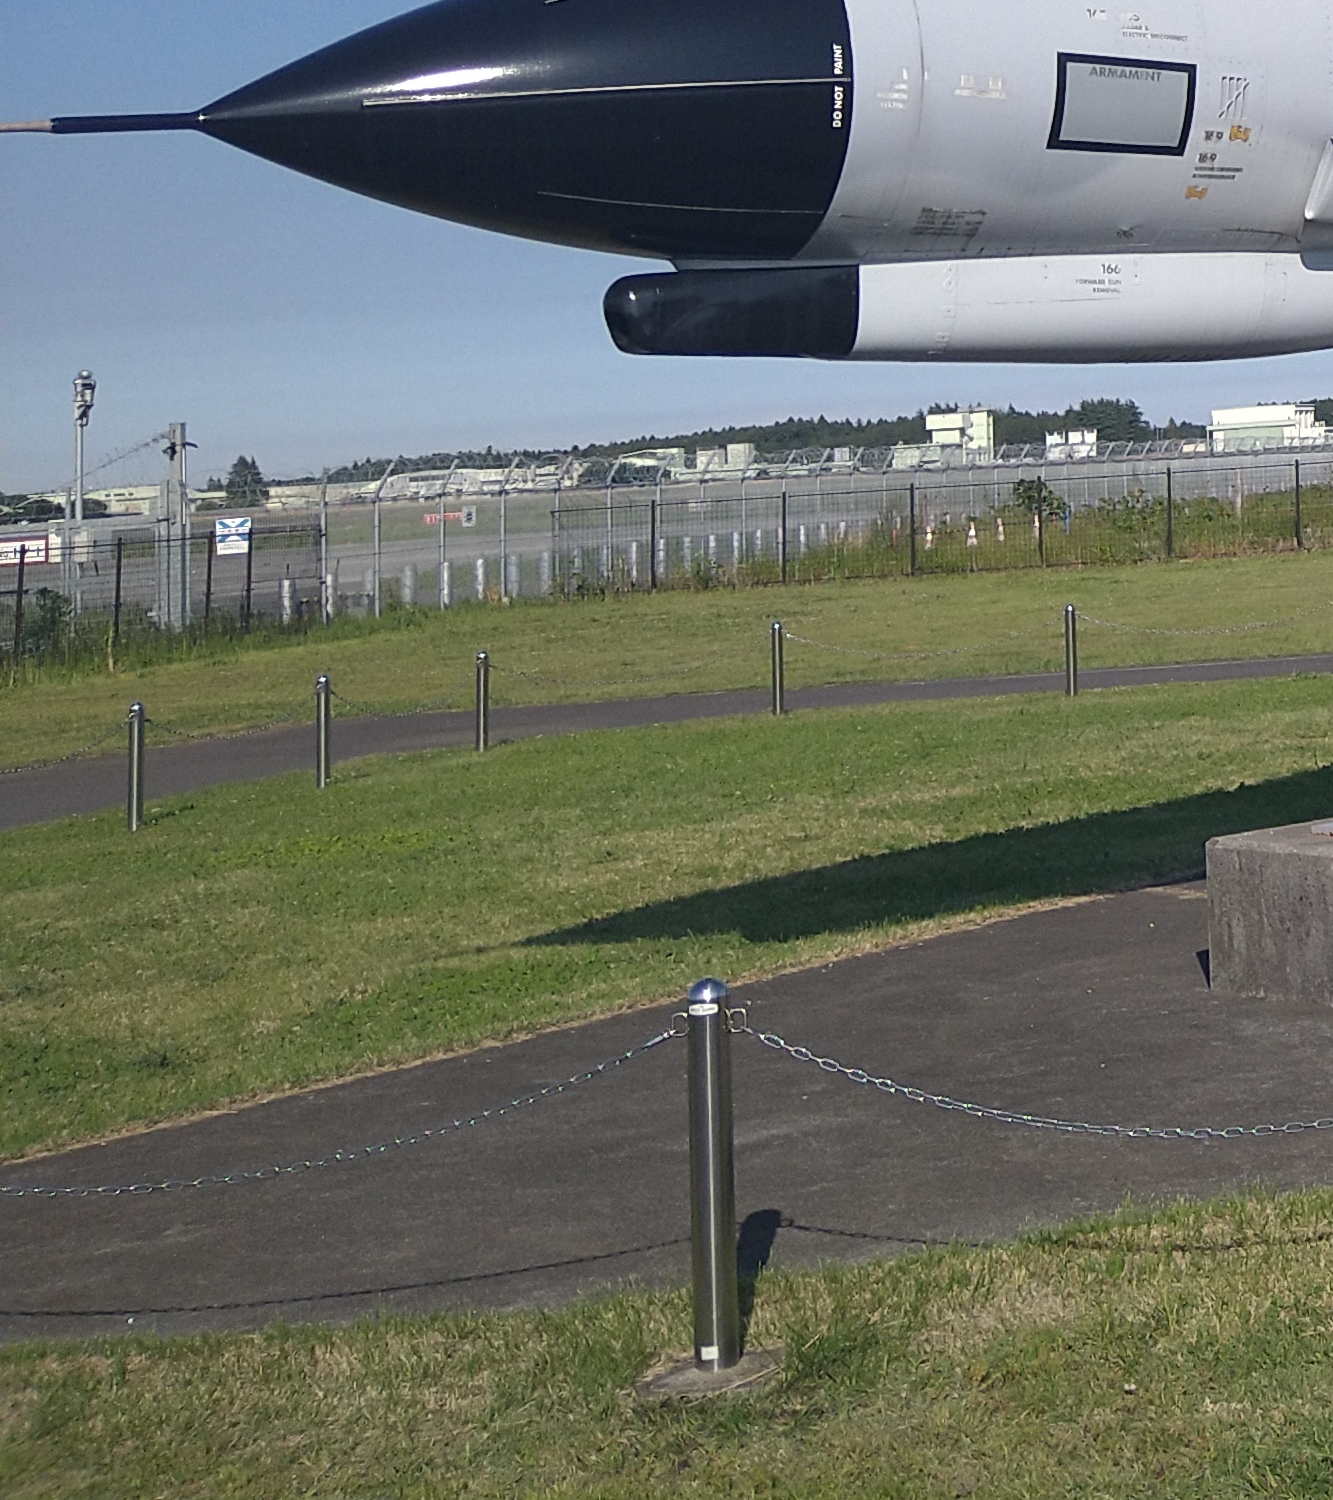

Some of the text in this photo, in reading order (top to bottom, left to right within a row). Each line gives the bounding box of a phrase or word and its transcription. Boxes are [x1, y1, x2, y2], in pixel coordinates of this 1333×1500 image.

[1089, 66, 1163, 82] ARMAMENT
[832, 43, 844, 128] DO NOT PAINT
[1101, 263, 1121, 275] 166
